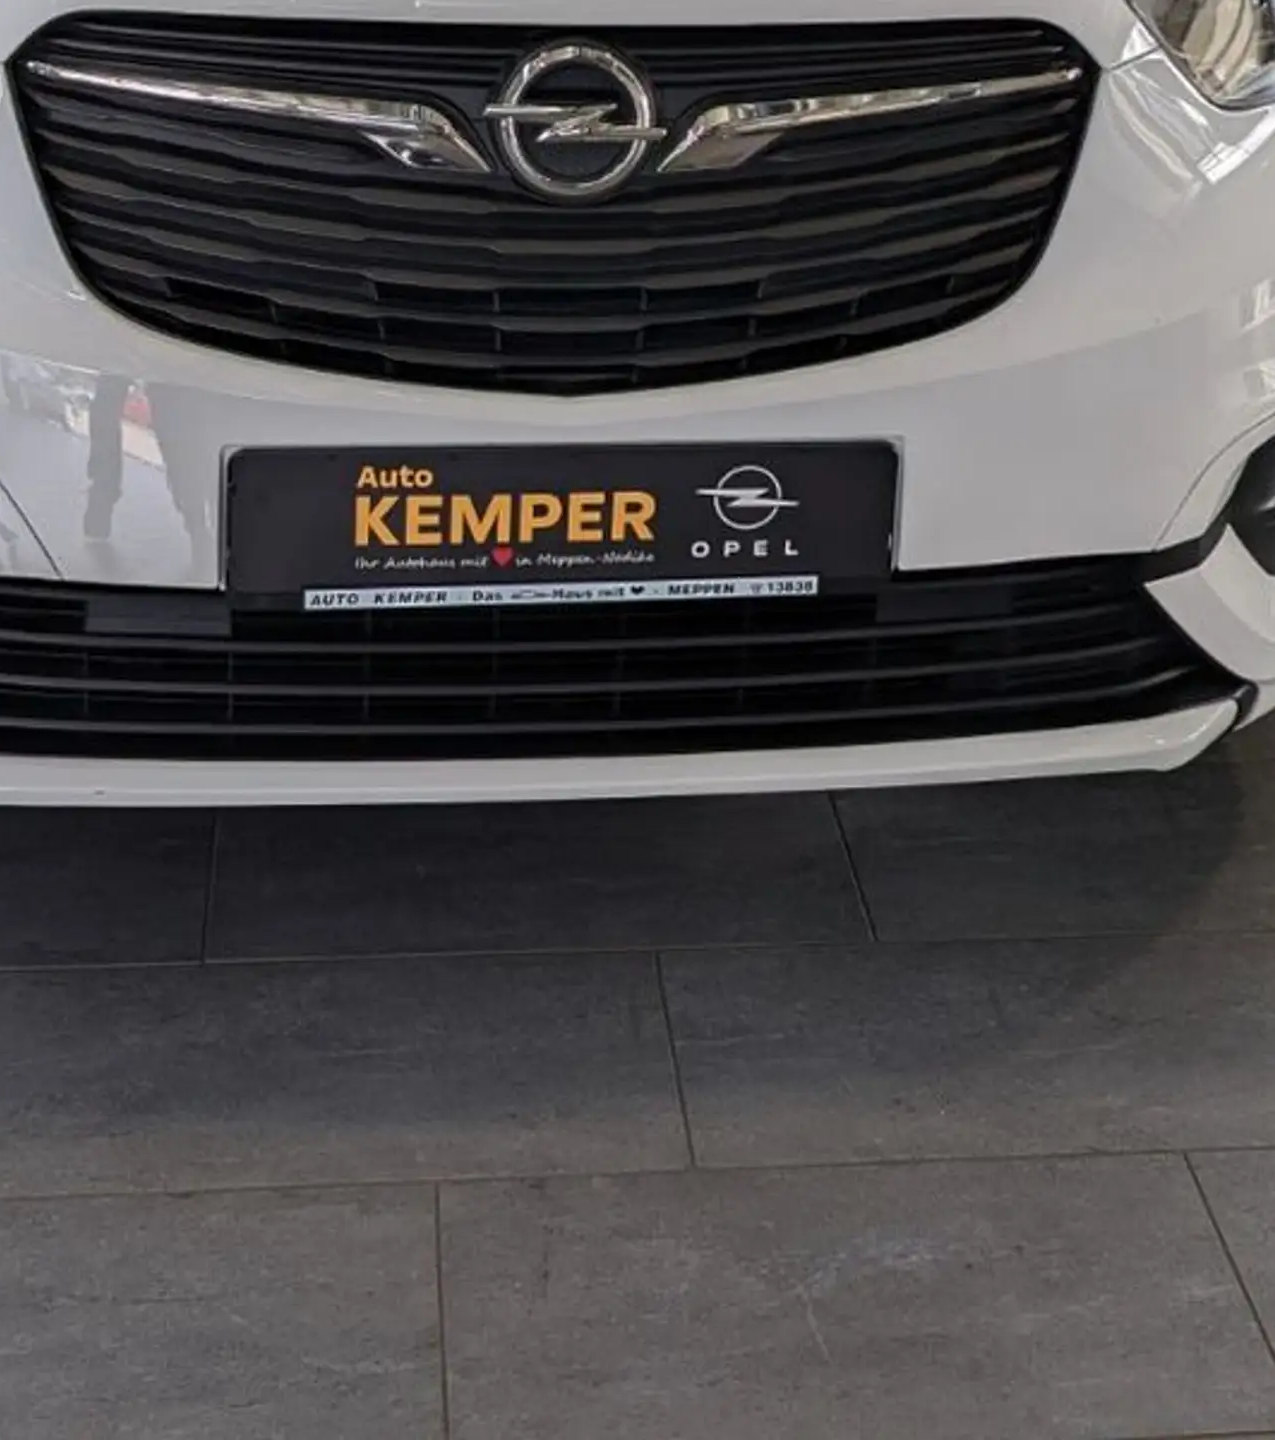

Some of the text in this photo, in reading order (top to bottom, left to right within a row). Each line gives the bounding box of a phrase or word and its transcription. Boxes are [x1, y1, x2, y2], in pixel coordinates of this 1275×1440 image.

[356, 465, 434, 489] Auto
[354, 490, 657, 547] KEMPER
[691, 539, 800, 559] OPEL
[354, 555, 381, 571] Ihr
[383, 554, 456, 570] Autohaus
[460, 554, 489, 569] mit
[515, 555, 533, 568] in
[310, 591, 360, 607] AUTO
[373, 589, 449, 605] KEMPER
[472, 588, 504, 603] Das
[667, 581, 735, 596] MEPPEN
